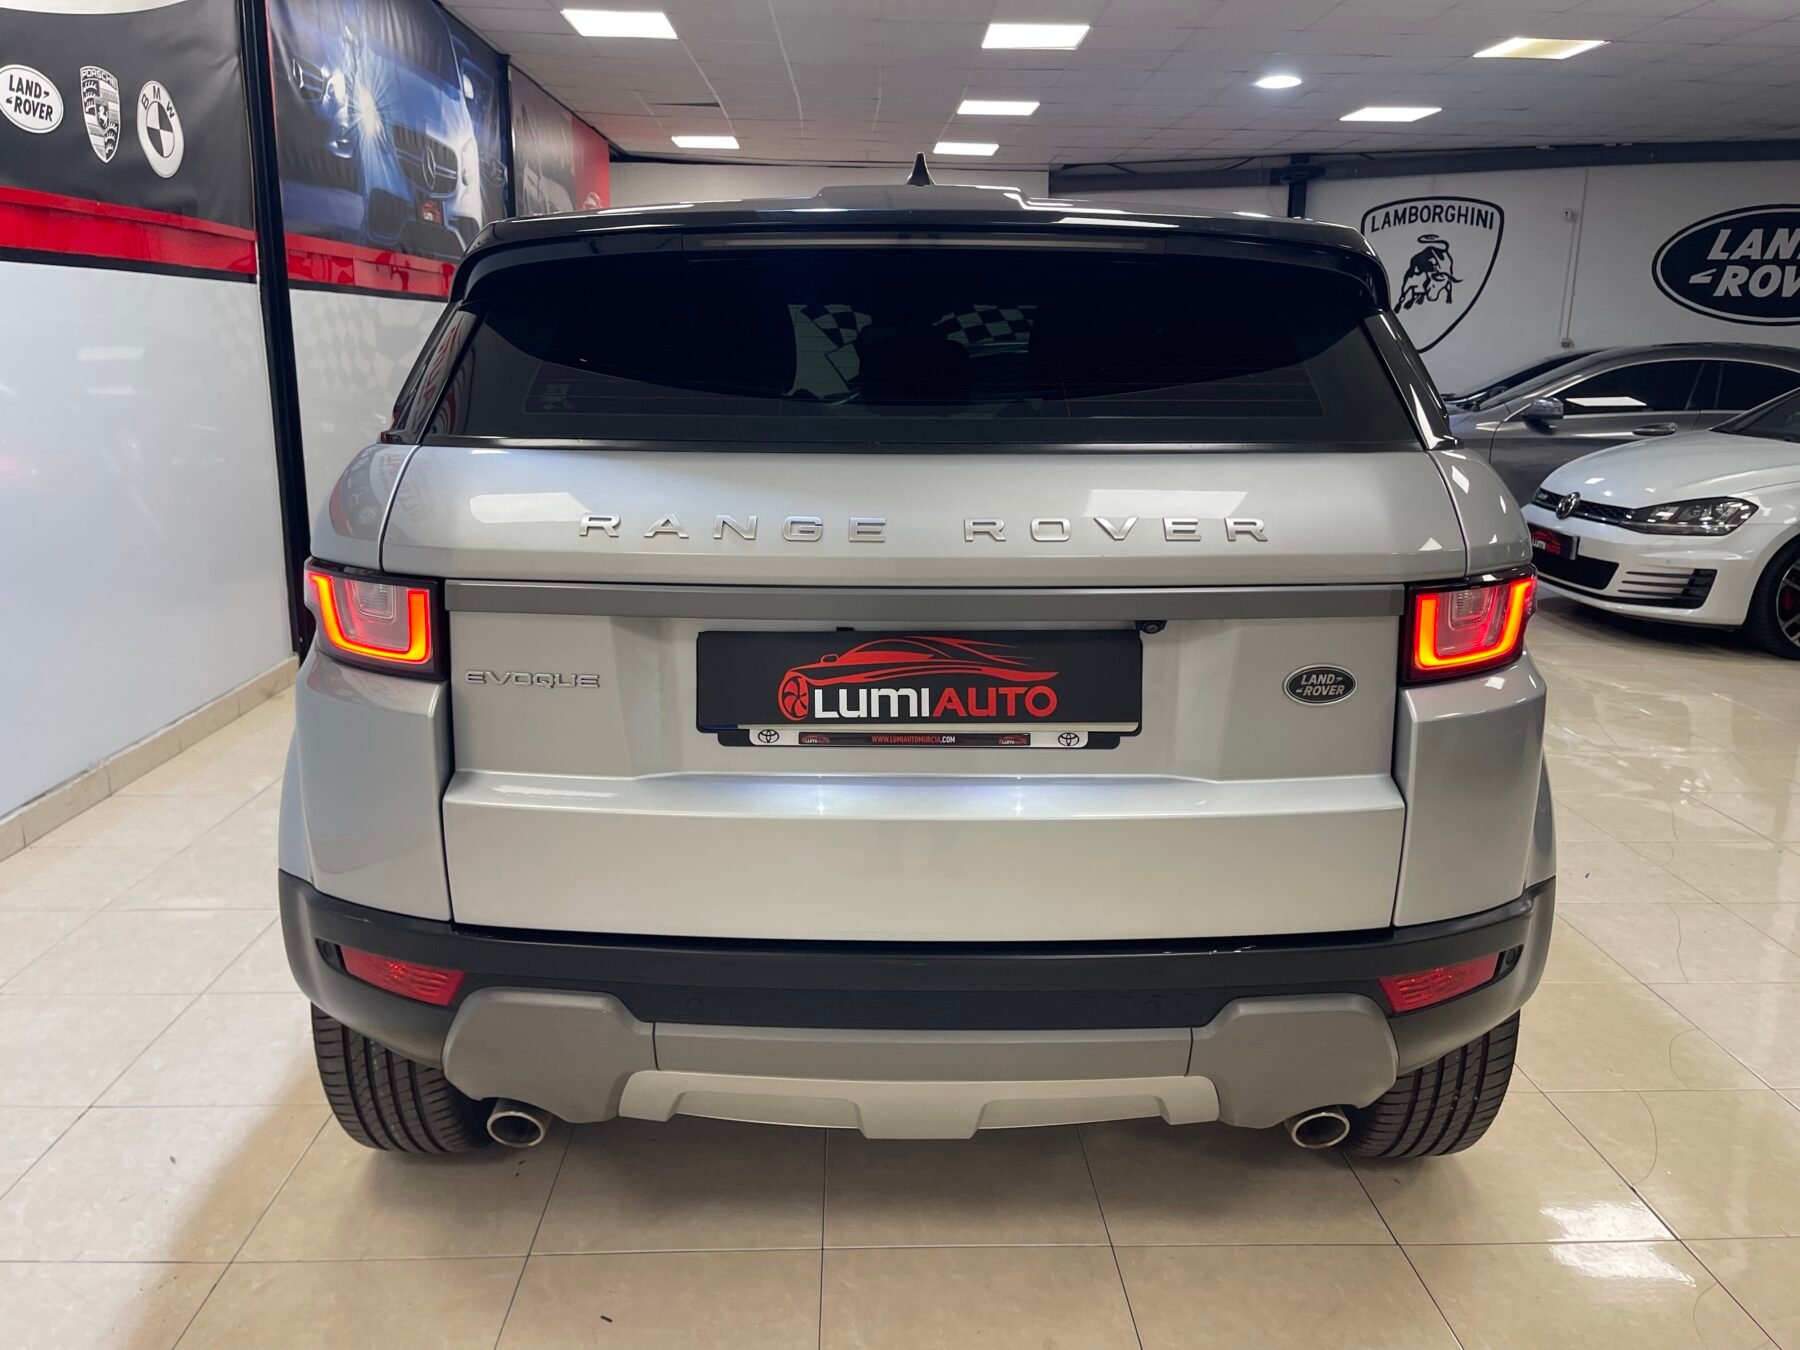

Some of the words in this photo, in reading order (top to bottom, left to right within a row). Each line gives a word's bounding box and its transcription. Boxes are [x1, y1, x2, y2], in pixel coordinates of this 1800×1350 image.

[8, 74, 42, 99] LAND
[14, 99, 54, 122] ROVER
[140, 85, 175, 118] BMW
[1370, 204, 1495, 233] LAMBORGHINI
[1706, 228, 1800, 260] LAN
[1712, 264, 1800, 298] ROV
[579, 512, 887, 543] RANGE
[963, 515, 1269, 542] ROVER
[465, 670, 600, 688] EVOQUE
[1301, 674, 1335, 685] LAND
[1302, 685, 1345, 696] ROVER
[871, 735, 956, 744] WWW.LUMIAUTOMURCIA.COM
